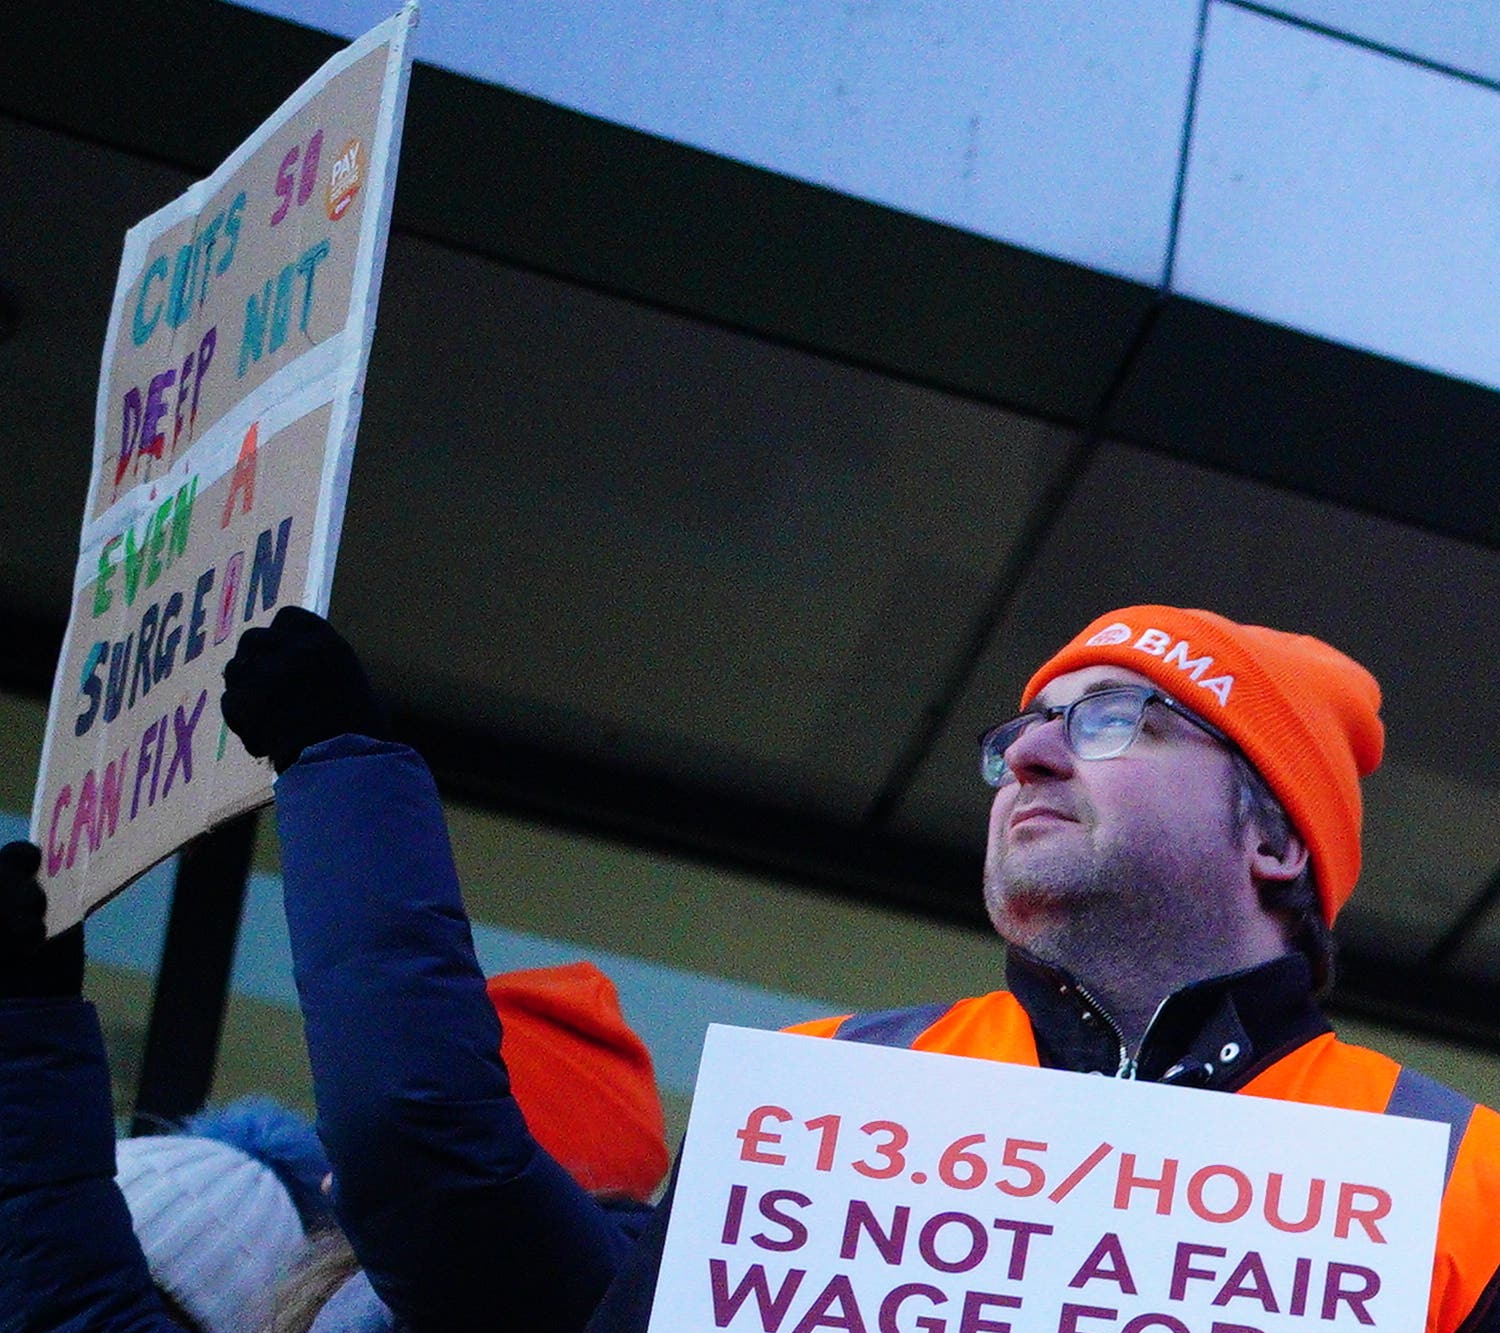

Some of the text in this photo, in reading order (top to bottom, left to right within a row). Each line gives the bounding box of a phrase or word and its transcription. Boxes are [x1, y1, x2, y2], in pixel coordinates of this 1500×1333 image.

[130, 128, 324, 347] CUTS SO
[332, 142, 360, 187] PAY
[110, 238, 331, 492] DEEP NOT
[91, 421, 259, 619] EVEN A
[74, 516, 293, 738] SURGEON
[1132, 628, 1235, 708] BMA
[46, 689, 209, 878] CAN FIX
[720, 1185, 1383, 1326] IS NOT A FAIR
[735, 1105, 1393, 1245] £13.65/HOUR
